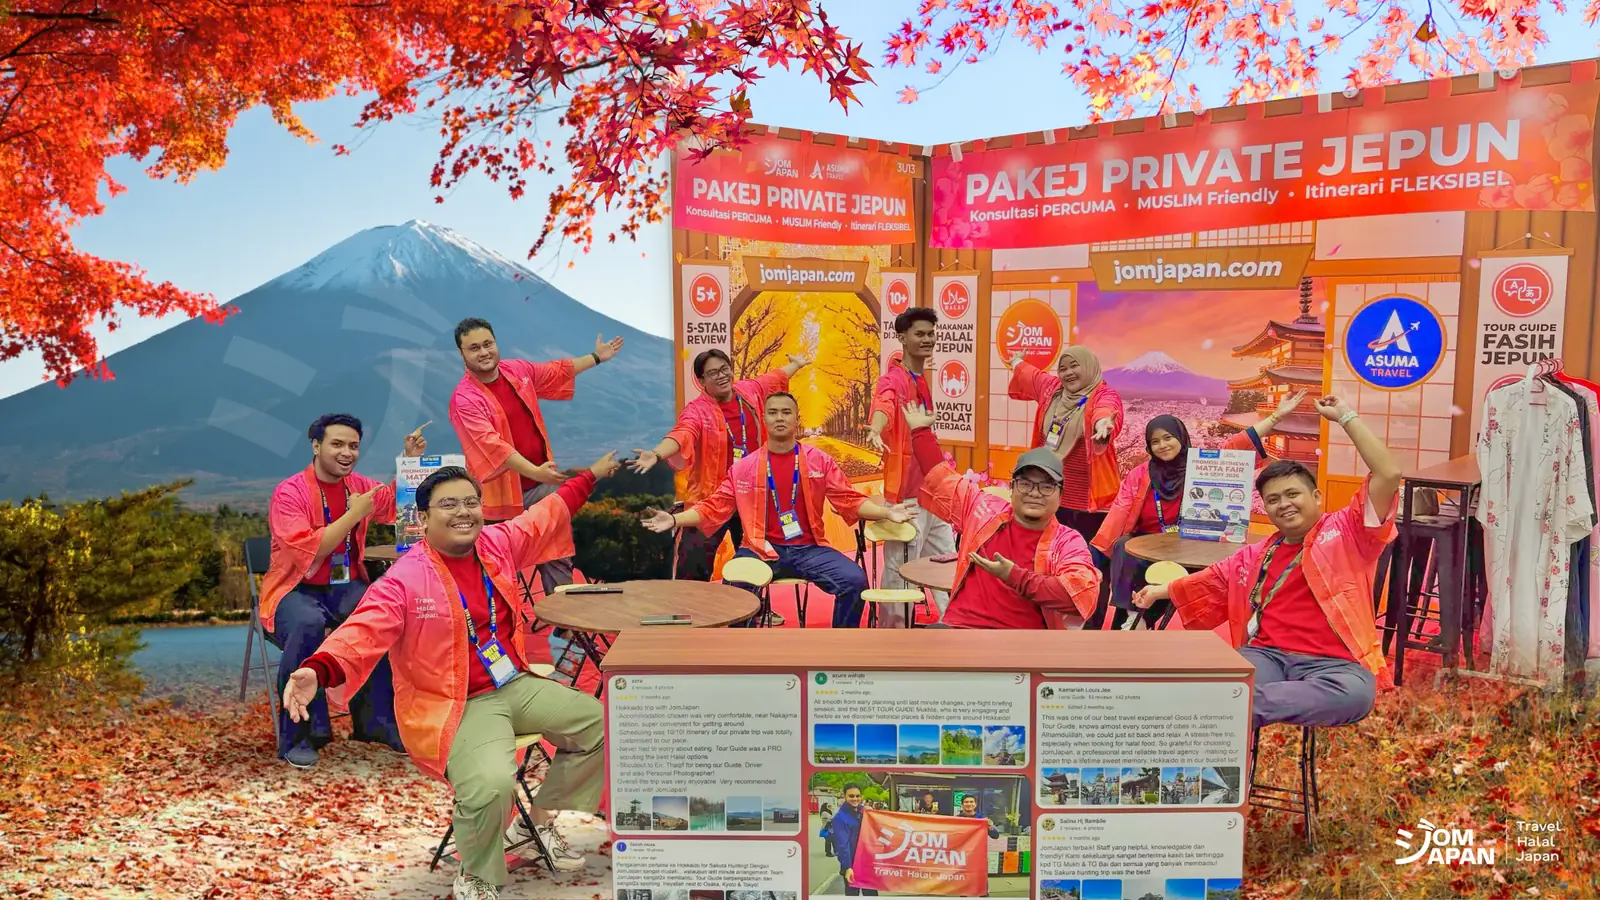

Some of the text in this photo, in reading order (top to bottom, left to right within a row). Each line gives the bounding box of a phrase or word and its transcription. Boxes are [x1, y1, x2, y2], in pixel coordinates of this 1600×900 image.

[966, 118, 1520, 205] PAKEJ PRIVATE JEPUN
[896, 161, 916, 174] 3U13
[692, 178, 907, 217] PAKEJ PRIVATE JEPUN
[969, 169, 1511, 223] Konsultasi PERCUMA MUSLIM Friendly Itinerari FLEKSIBEL
[685, 205, 912, 232] Konsultasi PERCUMA MUSLIM Friendly Itinerari FLEKSIBEL
[759, 263, 856, 285] jomjapan.com
[1113, 257, 1283, 285] jomjapan.com
[889, 291, 908, 306] 10+
[686, 321, 727, 334] 5-STAR
[935, 323, 974, 331] MAKANAN
[1483, 323, 1557, 332] TOUR GUIDE
[687, 334, 727, 345] REVIEW
[883, 331, 891, 339] DI
[935, 331, 974, 342] HALAL
[1483, 333, 1556, 349] FASIH
[935, 342, 973, 354] JEPUN
[1365, 355, 1420, 368] ASUMA
[1481, 351, 1555, 366] JEPUN
[1370, 368, 1413, 378] TRAVEL
[935, 402, 973, 413] WAKTU
[935, 411, 973, 424] SOLAT
[935, 422, 973, 432] TERJAGA
[1195, 465, 1245, 474] MATTA FAIR
[406, 473, 430, 481] MATT
[857, 699, 871, 707] early
[872, 699, 895, 708] planning
[703, 713, 716, 721] very
[769, 711, 798, 721] Nakajima
[1041, 713, 1055, 721] This
[1083, 713, 1091, 721] of
[1103, 713, 1117, 721] best
[1118, 713, 1136, 721] travel
[1137, 713, 1173, 723] experience!
[1174, 713, 1192, 721] Good
[1193, 713, 1198, 721] &
[1041, 722, 1056, 730] Tour
[1079, 722, 1100, 730] knows
[1100, 722, 1121, 730] almost
[1122, 723, 1140, 732] every
[1041, 740, 1072, 749] especially
[1073, 740, 1091, 748] when
[1091, 740, 1114, 749] looking
[1114, 740, 1124, 748] for
[1125, 740, 1140, 748] halal
[1168, 740, 1193, 749] grateful
[1203, 740, 1231, 748] choosing
[874, 866, 966, 882] Travel Halal Japan
[1040, 869, 1053, 877] This
[1054, 869, 1076, 877] Sakura
[1076, 869, 1100, 878] hunting
[1100, 869, 1111, 878] trip
[1124, 869, 1135, 877] the
